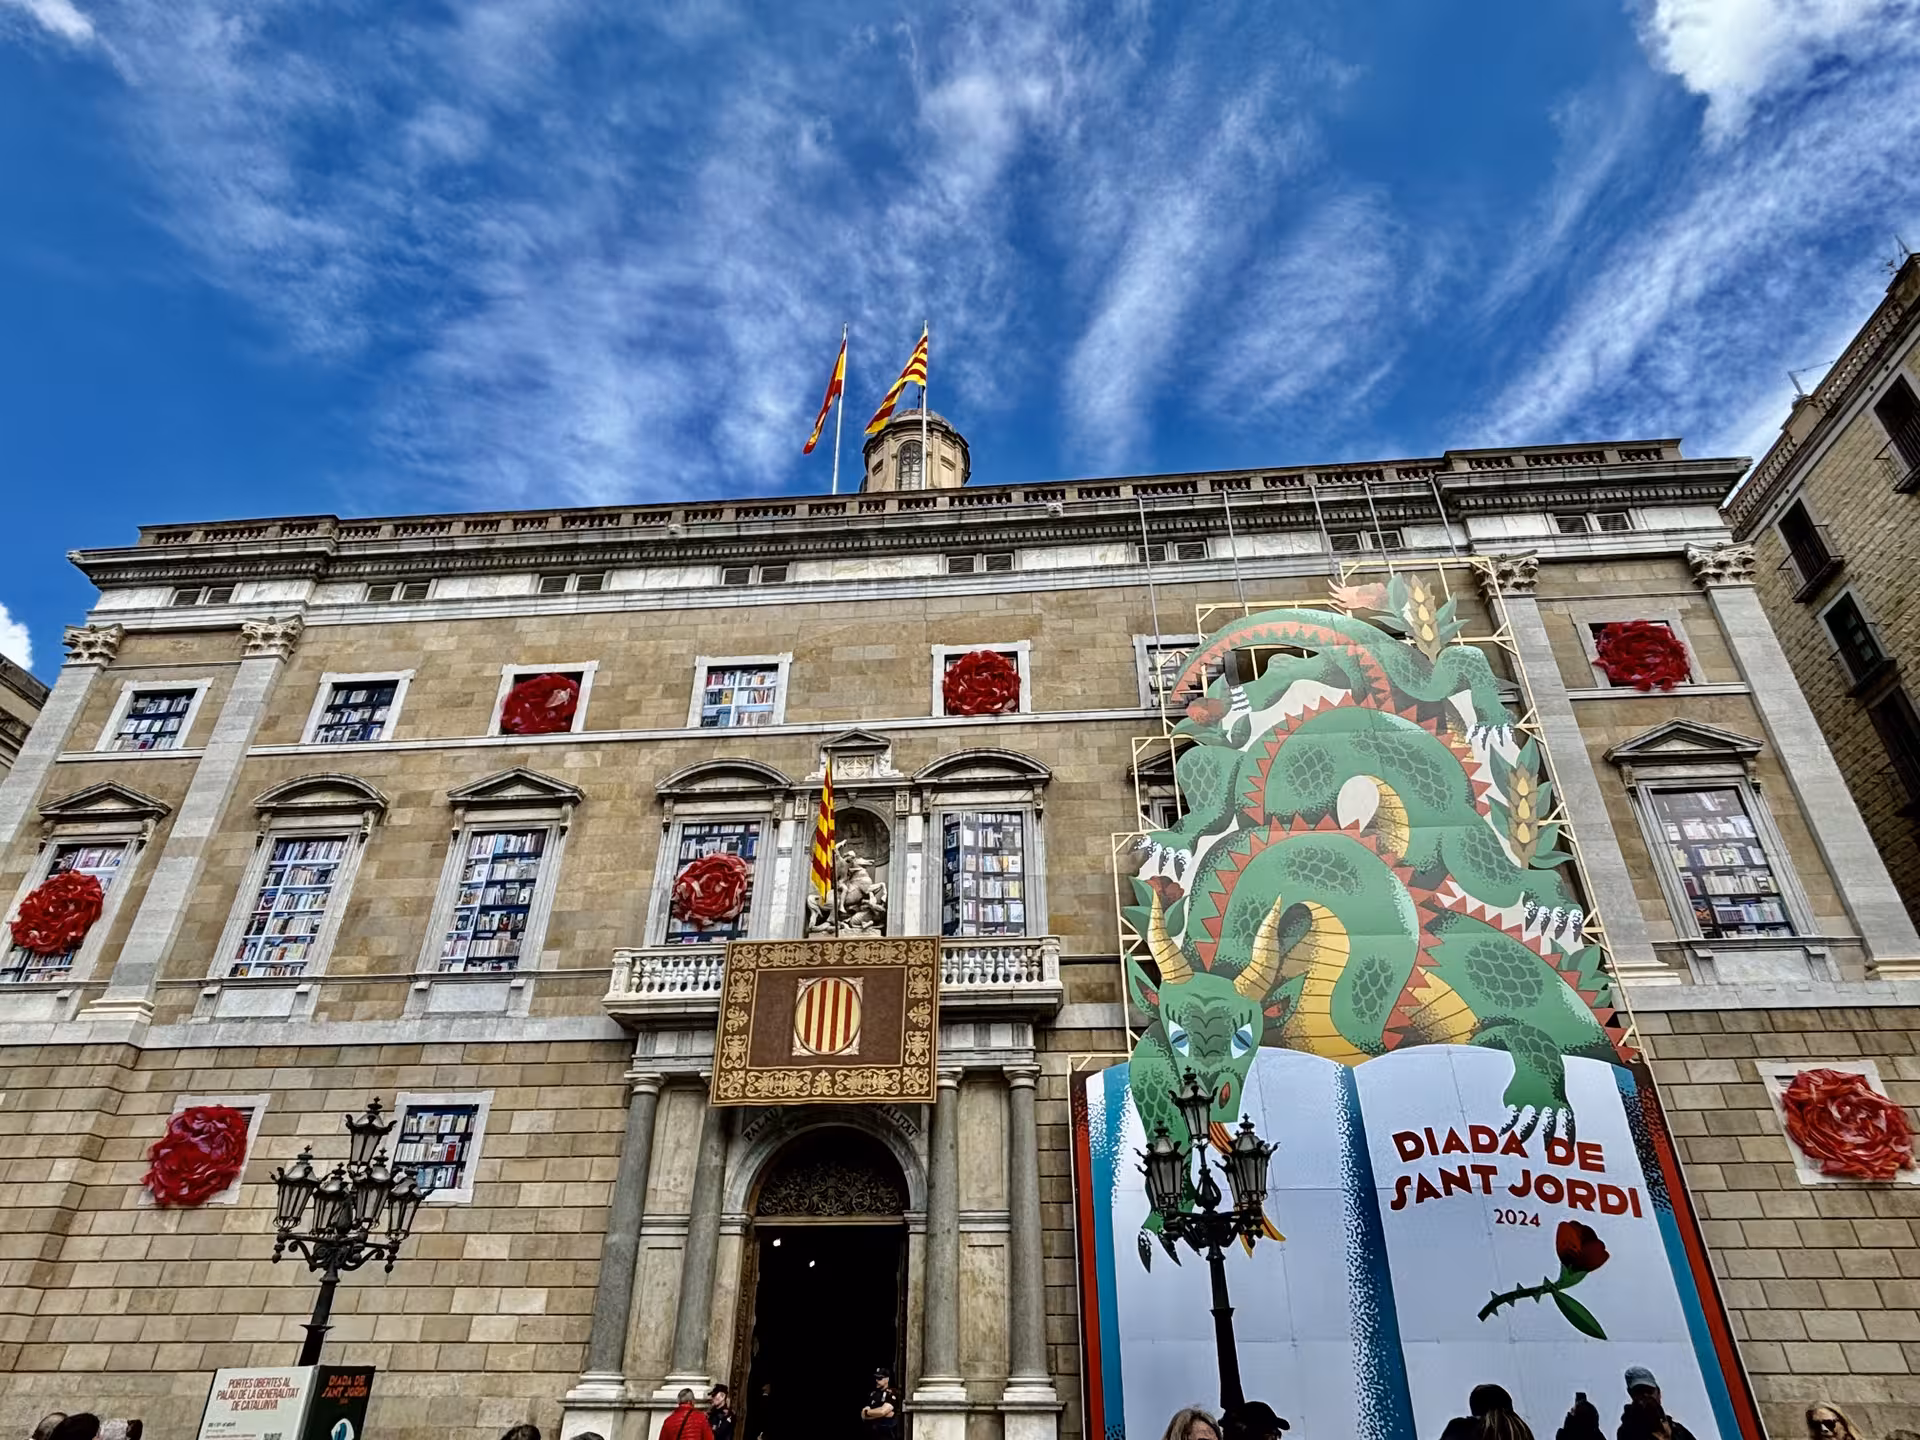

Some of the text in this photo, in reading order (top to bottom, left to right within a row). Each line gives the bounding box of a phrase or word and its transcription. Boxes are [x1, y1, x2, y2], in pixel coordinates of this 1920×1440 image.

[743, 1104, 918, 1141] PALAU RALITAT
[1392, 1124, 1606, 1173] DIADA DE
[1390, 1164, 1643, 1218] SANT JORDI
[1493, 1208, 1541, 1227] 2024
[228, 1377, 291, 1389] PORTES OBERTES AL
[328, 1375, 366, 1386] DIADA DE
[216, 1387, 300, 1400] PALAU DE LA GENERALITAT
[231, 1400, 278, 1411] DE CATALUNYA
